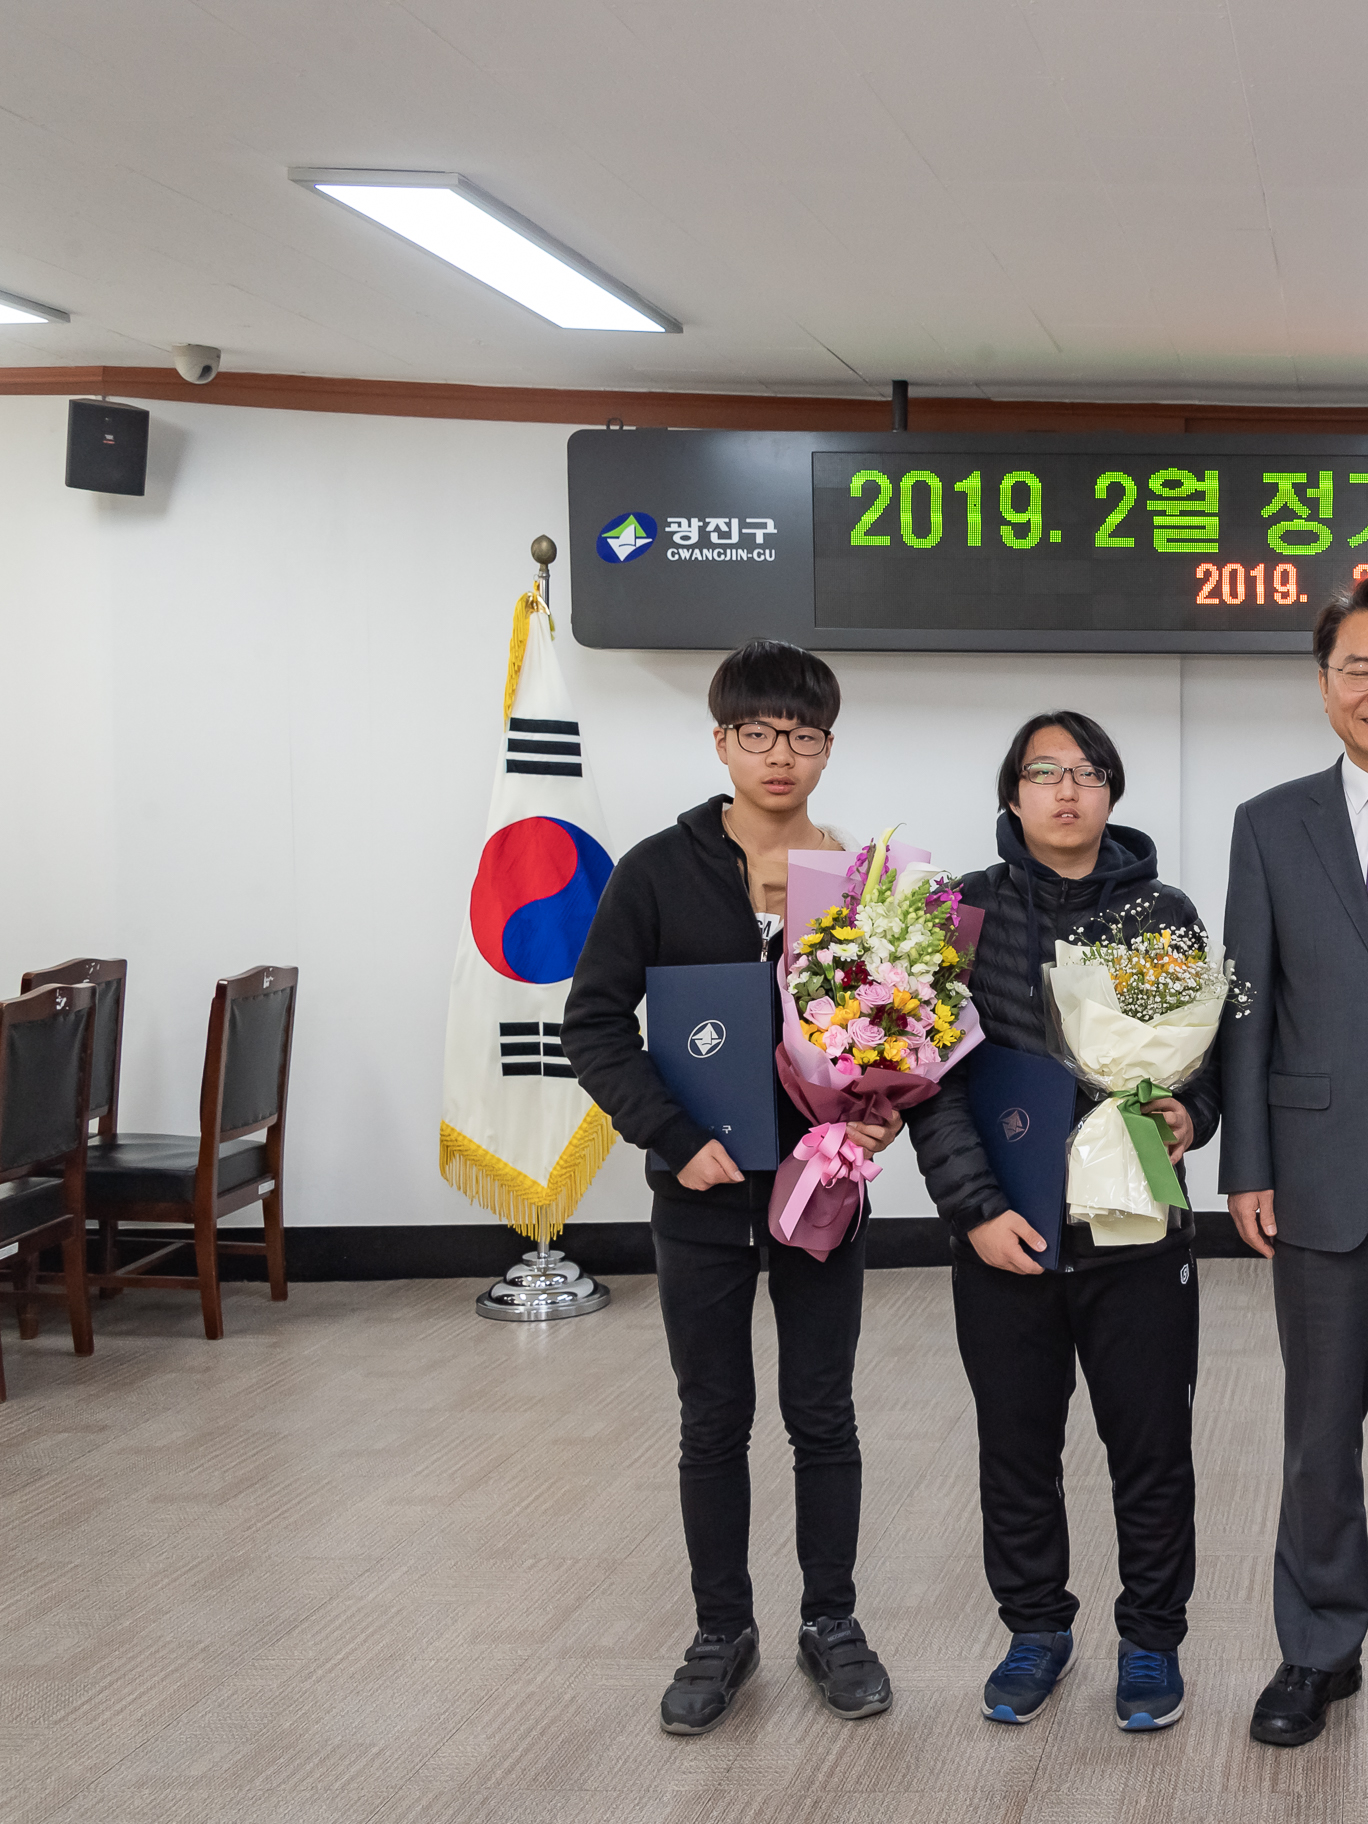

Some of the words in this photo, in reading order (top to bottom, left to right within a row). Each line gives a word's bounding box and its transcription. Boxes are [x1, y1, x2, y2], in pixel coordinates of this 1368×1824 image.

[850, 470, 1063, 550] 2019.
[1095, 468, 1221, 554] 2월
[665, 517, 778, 546] 광진구
[667, 548, 777, 562] GWANGJIN-GU
[1196, 563, 1309, 606] 2019.
